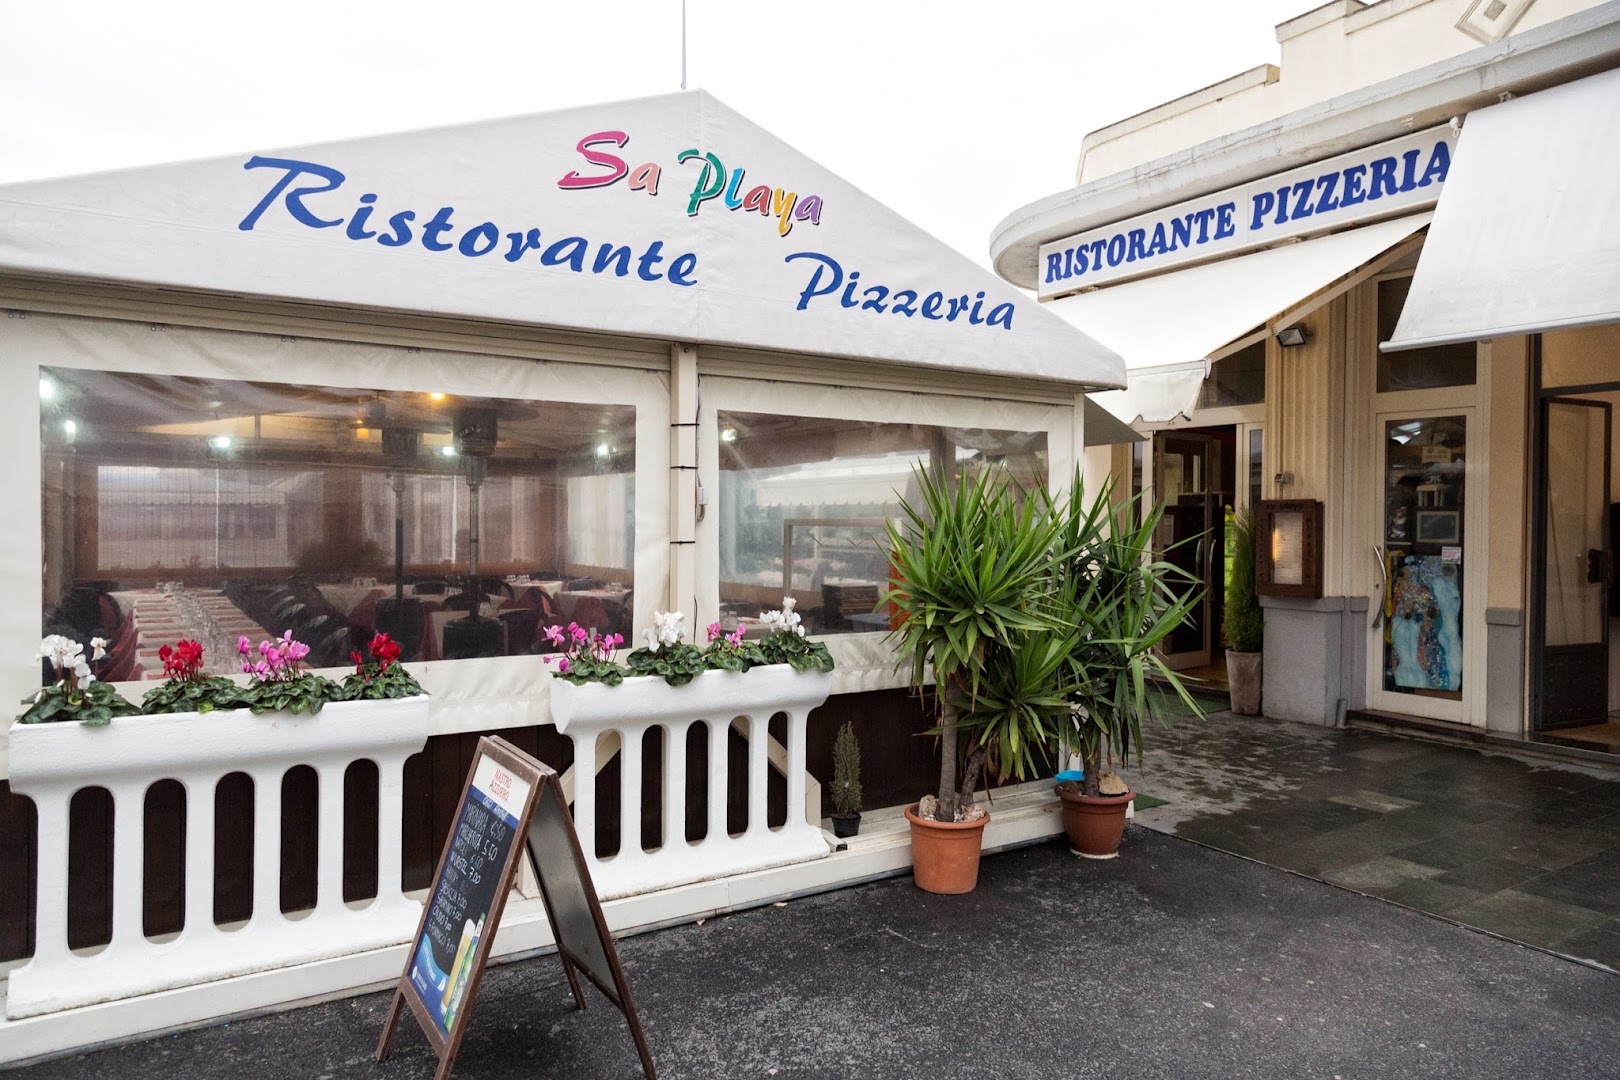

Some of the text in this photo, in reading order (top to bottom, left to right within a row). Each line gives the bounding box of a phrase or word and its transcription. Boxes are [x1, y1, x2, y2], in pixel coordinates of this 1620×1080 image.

[238, 155, 698, 286] Ristorante
[557, 130, 822, 237] Sa Playa
[1044, 140, 1451, 284] RISTORANTE PIZZERIA
[785, 252, 1015, 331] Pizzeria
[489, 779, 510, 801] AZZURRO
[495, 767, 512, 789] NASTRO
